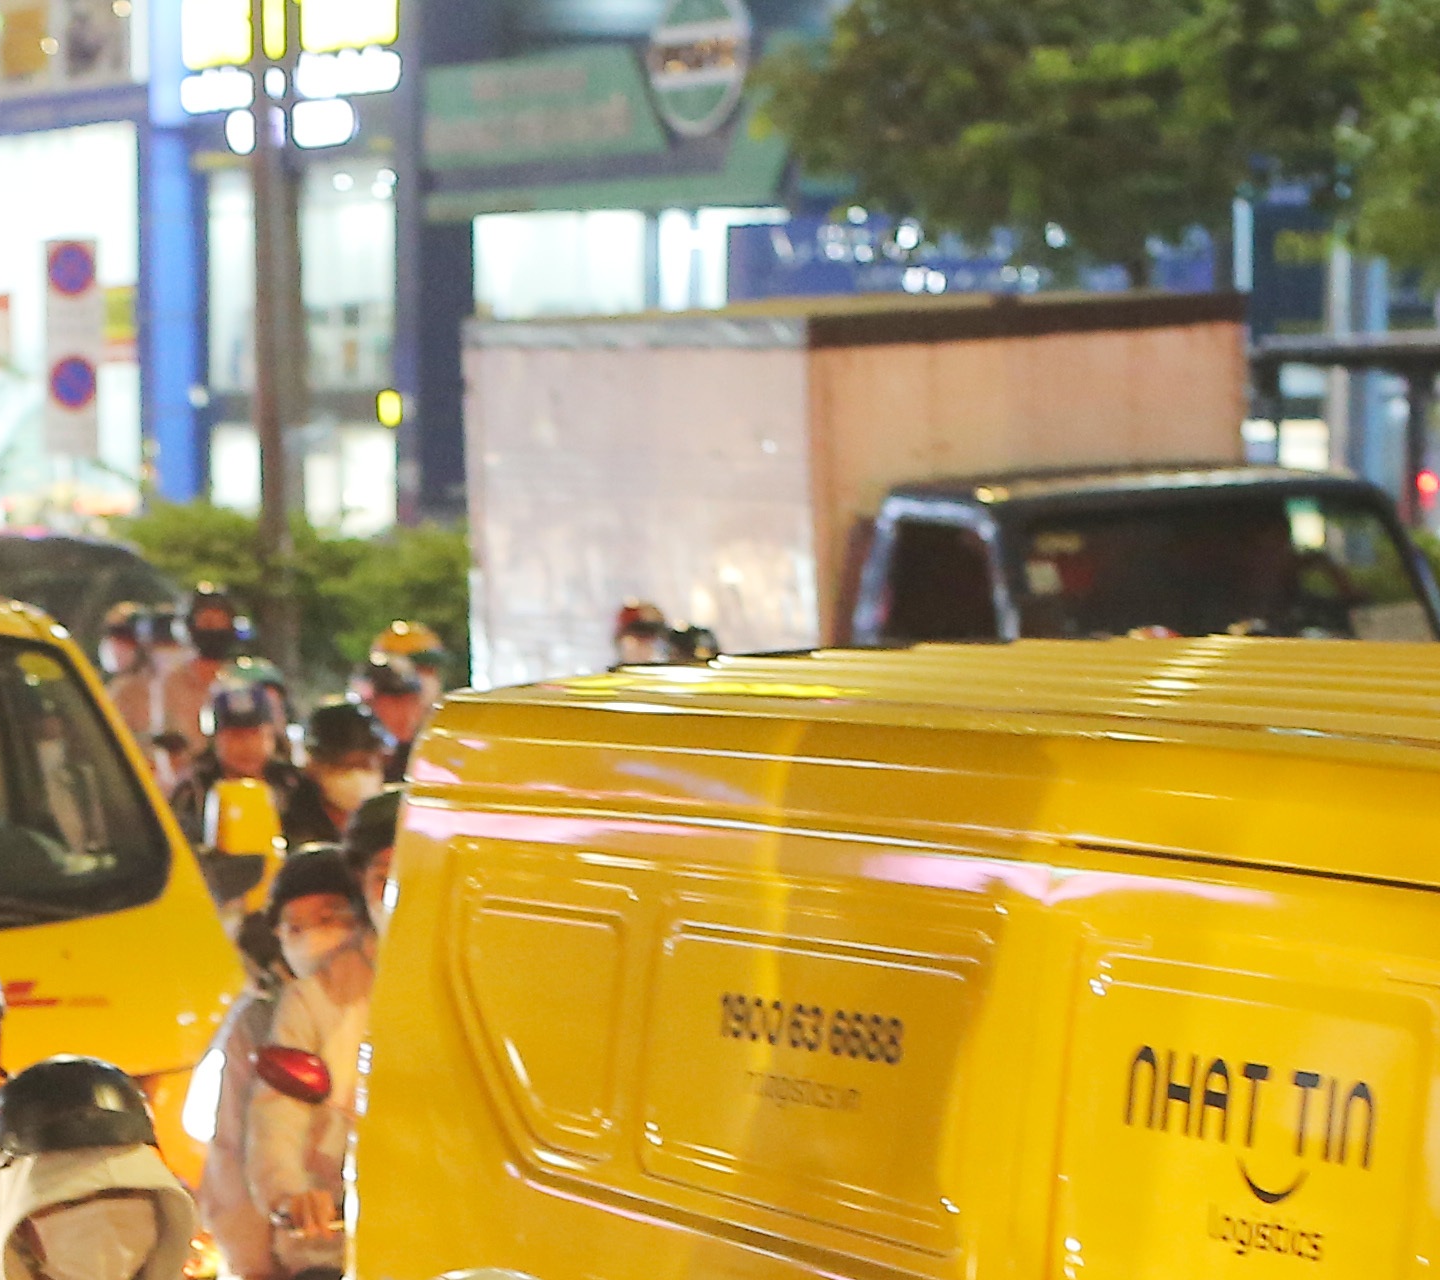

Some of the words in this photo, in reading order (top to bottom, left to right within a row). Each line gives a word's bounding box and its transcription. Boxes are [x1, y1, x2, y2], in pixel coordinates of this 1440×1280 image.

[720, 992, 783, 1045] 1900
[789, 1004, 824, 1052] 63
[1208, 1204, 1324, 1262] logistics
